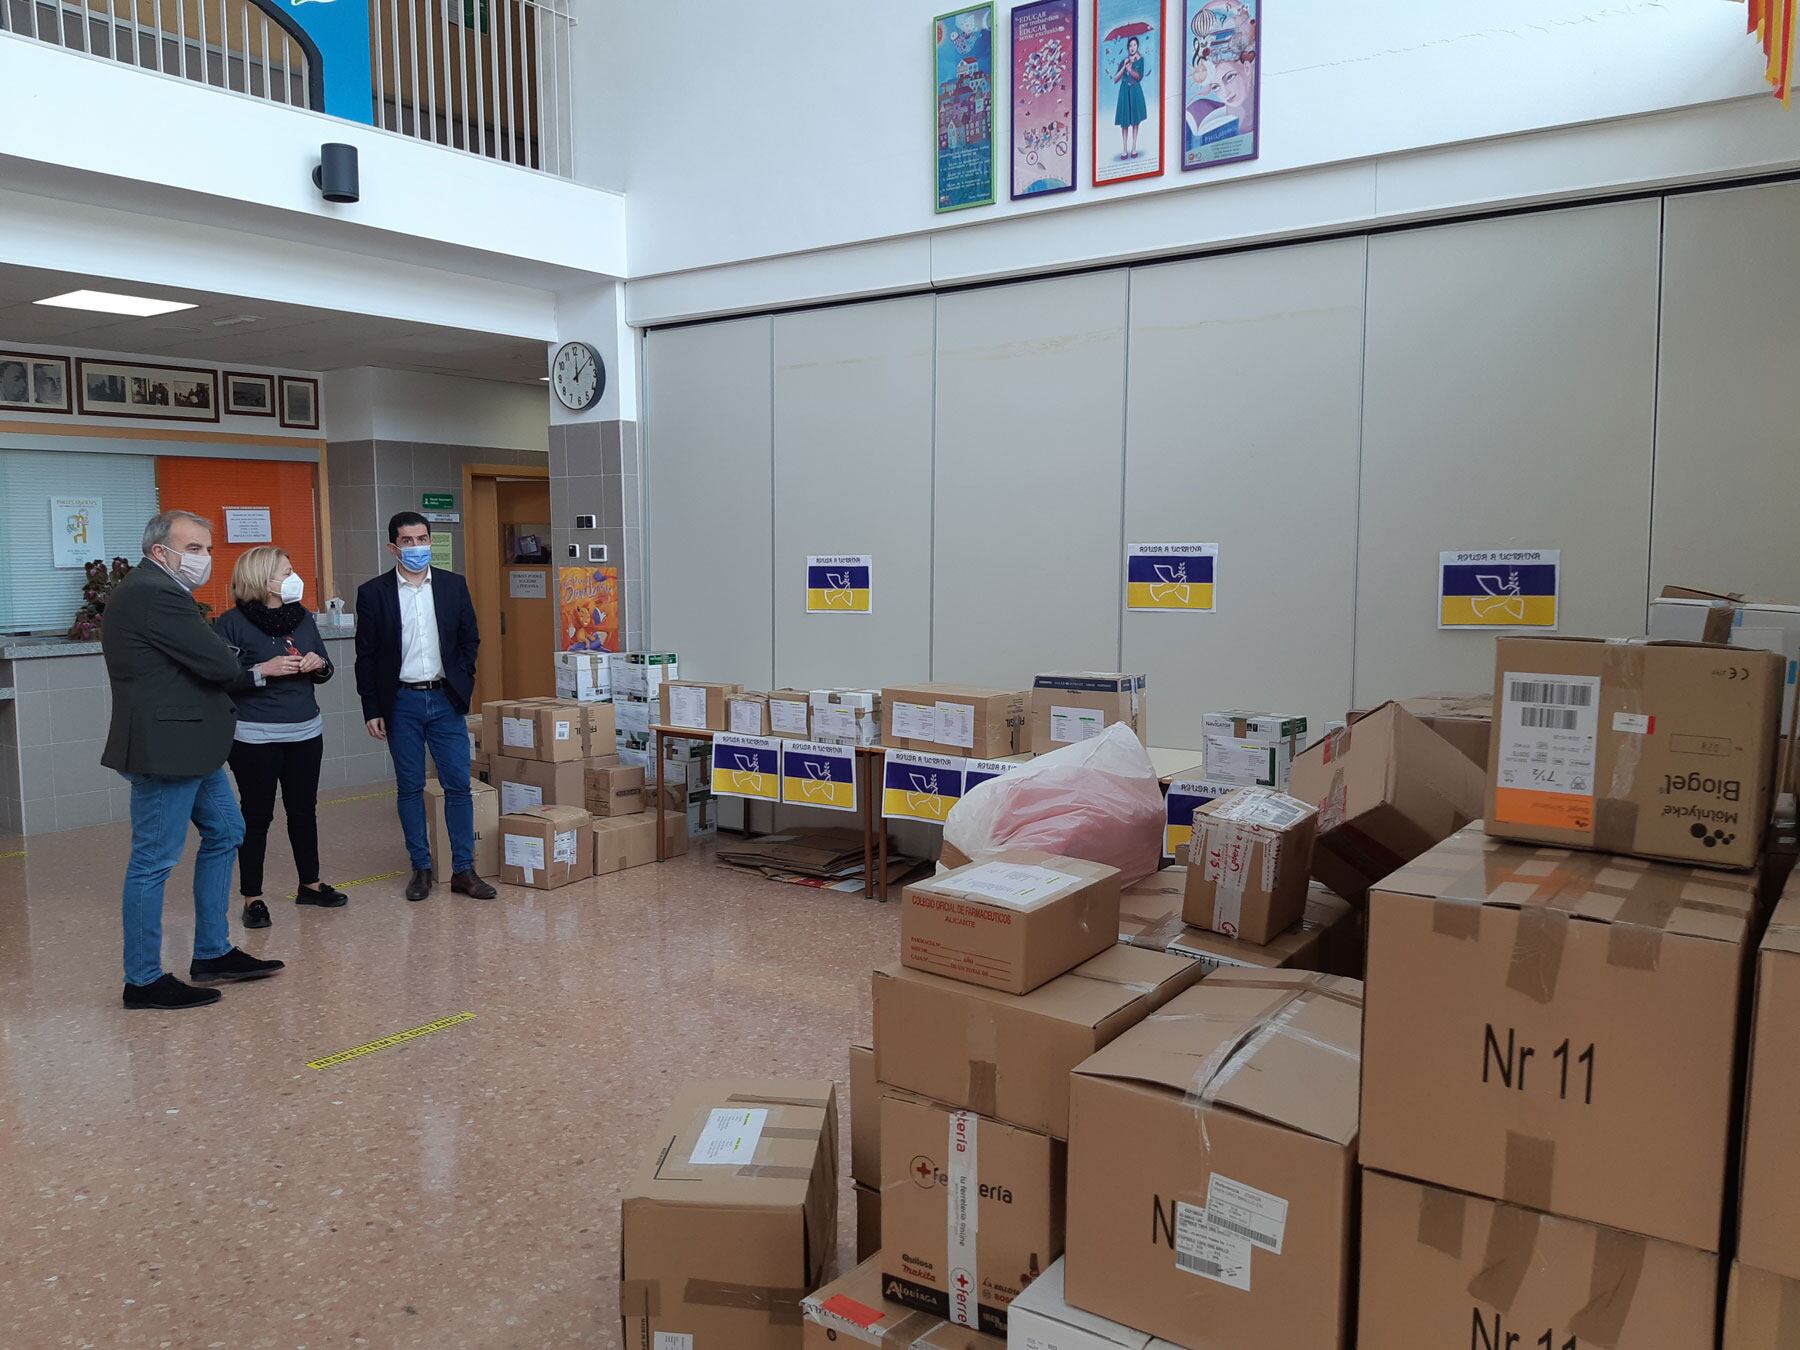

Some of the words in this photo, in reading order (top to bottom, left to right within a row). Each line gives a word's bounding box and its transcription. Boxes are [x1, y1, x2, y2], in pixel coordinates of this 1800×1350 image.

[1664, 772, 1740, 801] Biogel
[912, 895, 935, 909] COLEGIO
[936, 901, 955, 913] OFICIAL
[956, 904, 965, 915] DE
[945, 916, 976, 928] ALICANTE
[1482, 1023, 1535, 1091] Nr
[1553, 1038, 1595, 1105] 11
[901, 1253, 933, 1271] Quilosa
